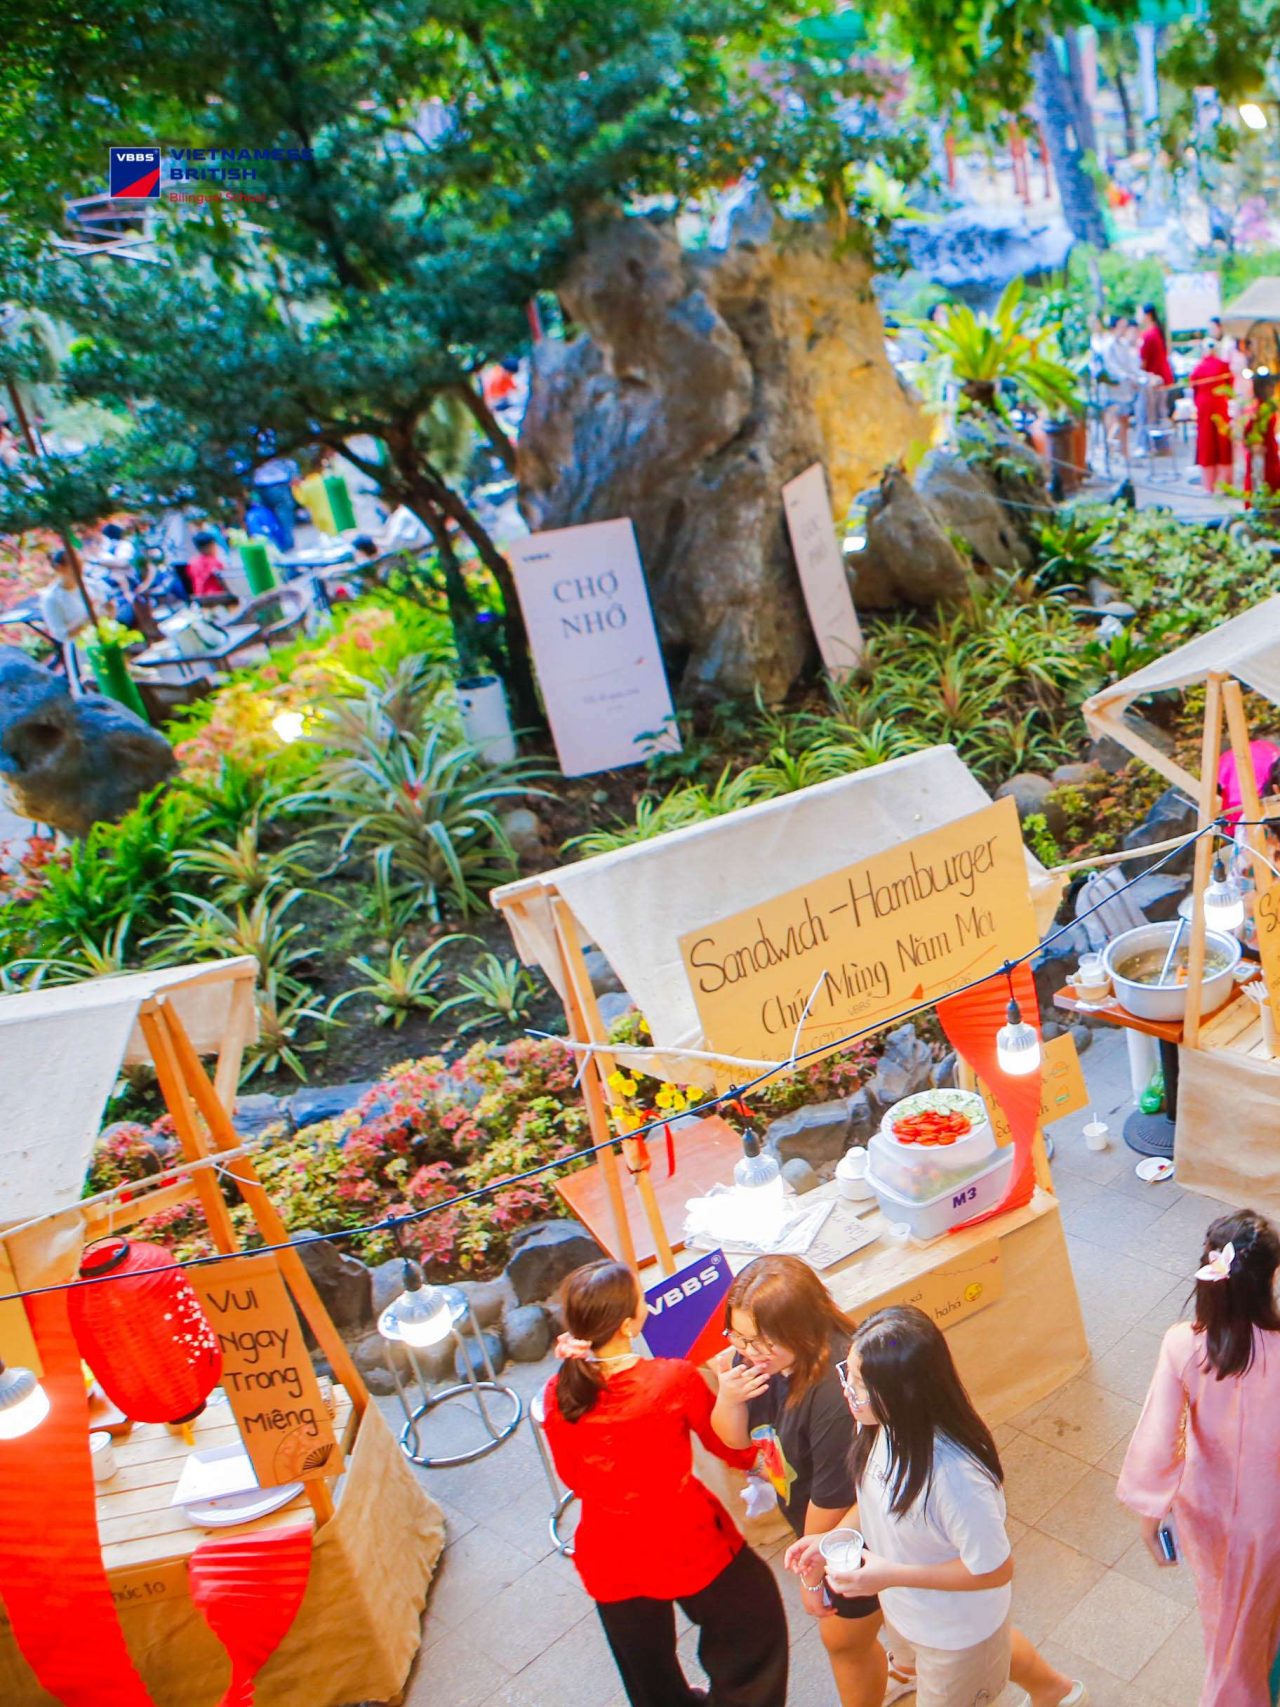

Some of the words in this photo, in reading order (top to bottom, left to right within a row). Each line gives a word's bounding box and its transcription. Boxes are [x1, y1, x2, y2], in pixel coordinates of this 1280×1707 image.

[552, 569, 619, 603] CHỢ
[952, 1186, 978, 1209] M3
[207, 1288, 259, 1313] Vui
[647, 1265, 721, 1316] VBBS
[217, 1328, 289, 1364] Ngay
[224, 1367, 303, 1398] Trong
[244, 1409, 319, 1437] Miệng
